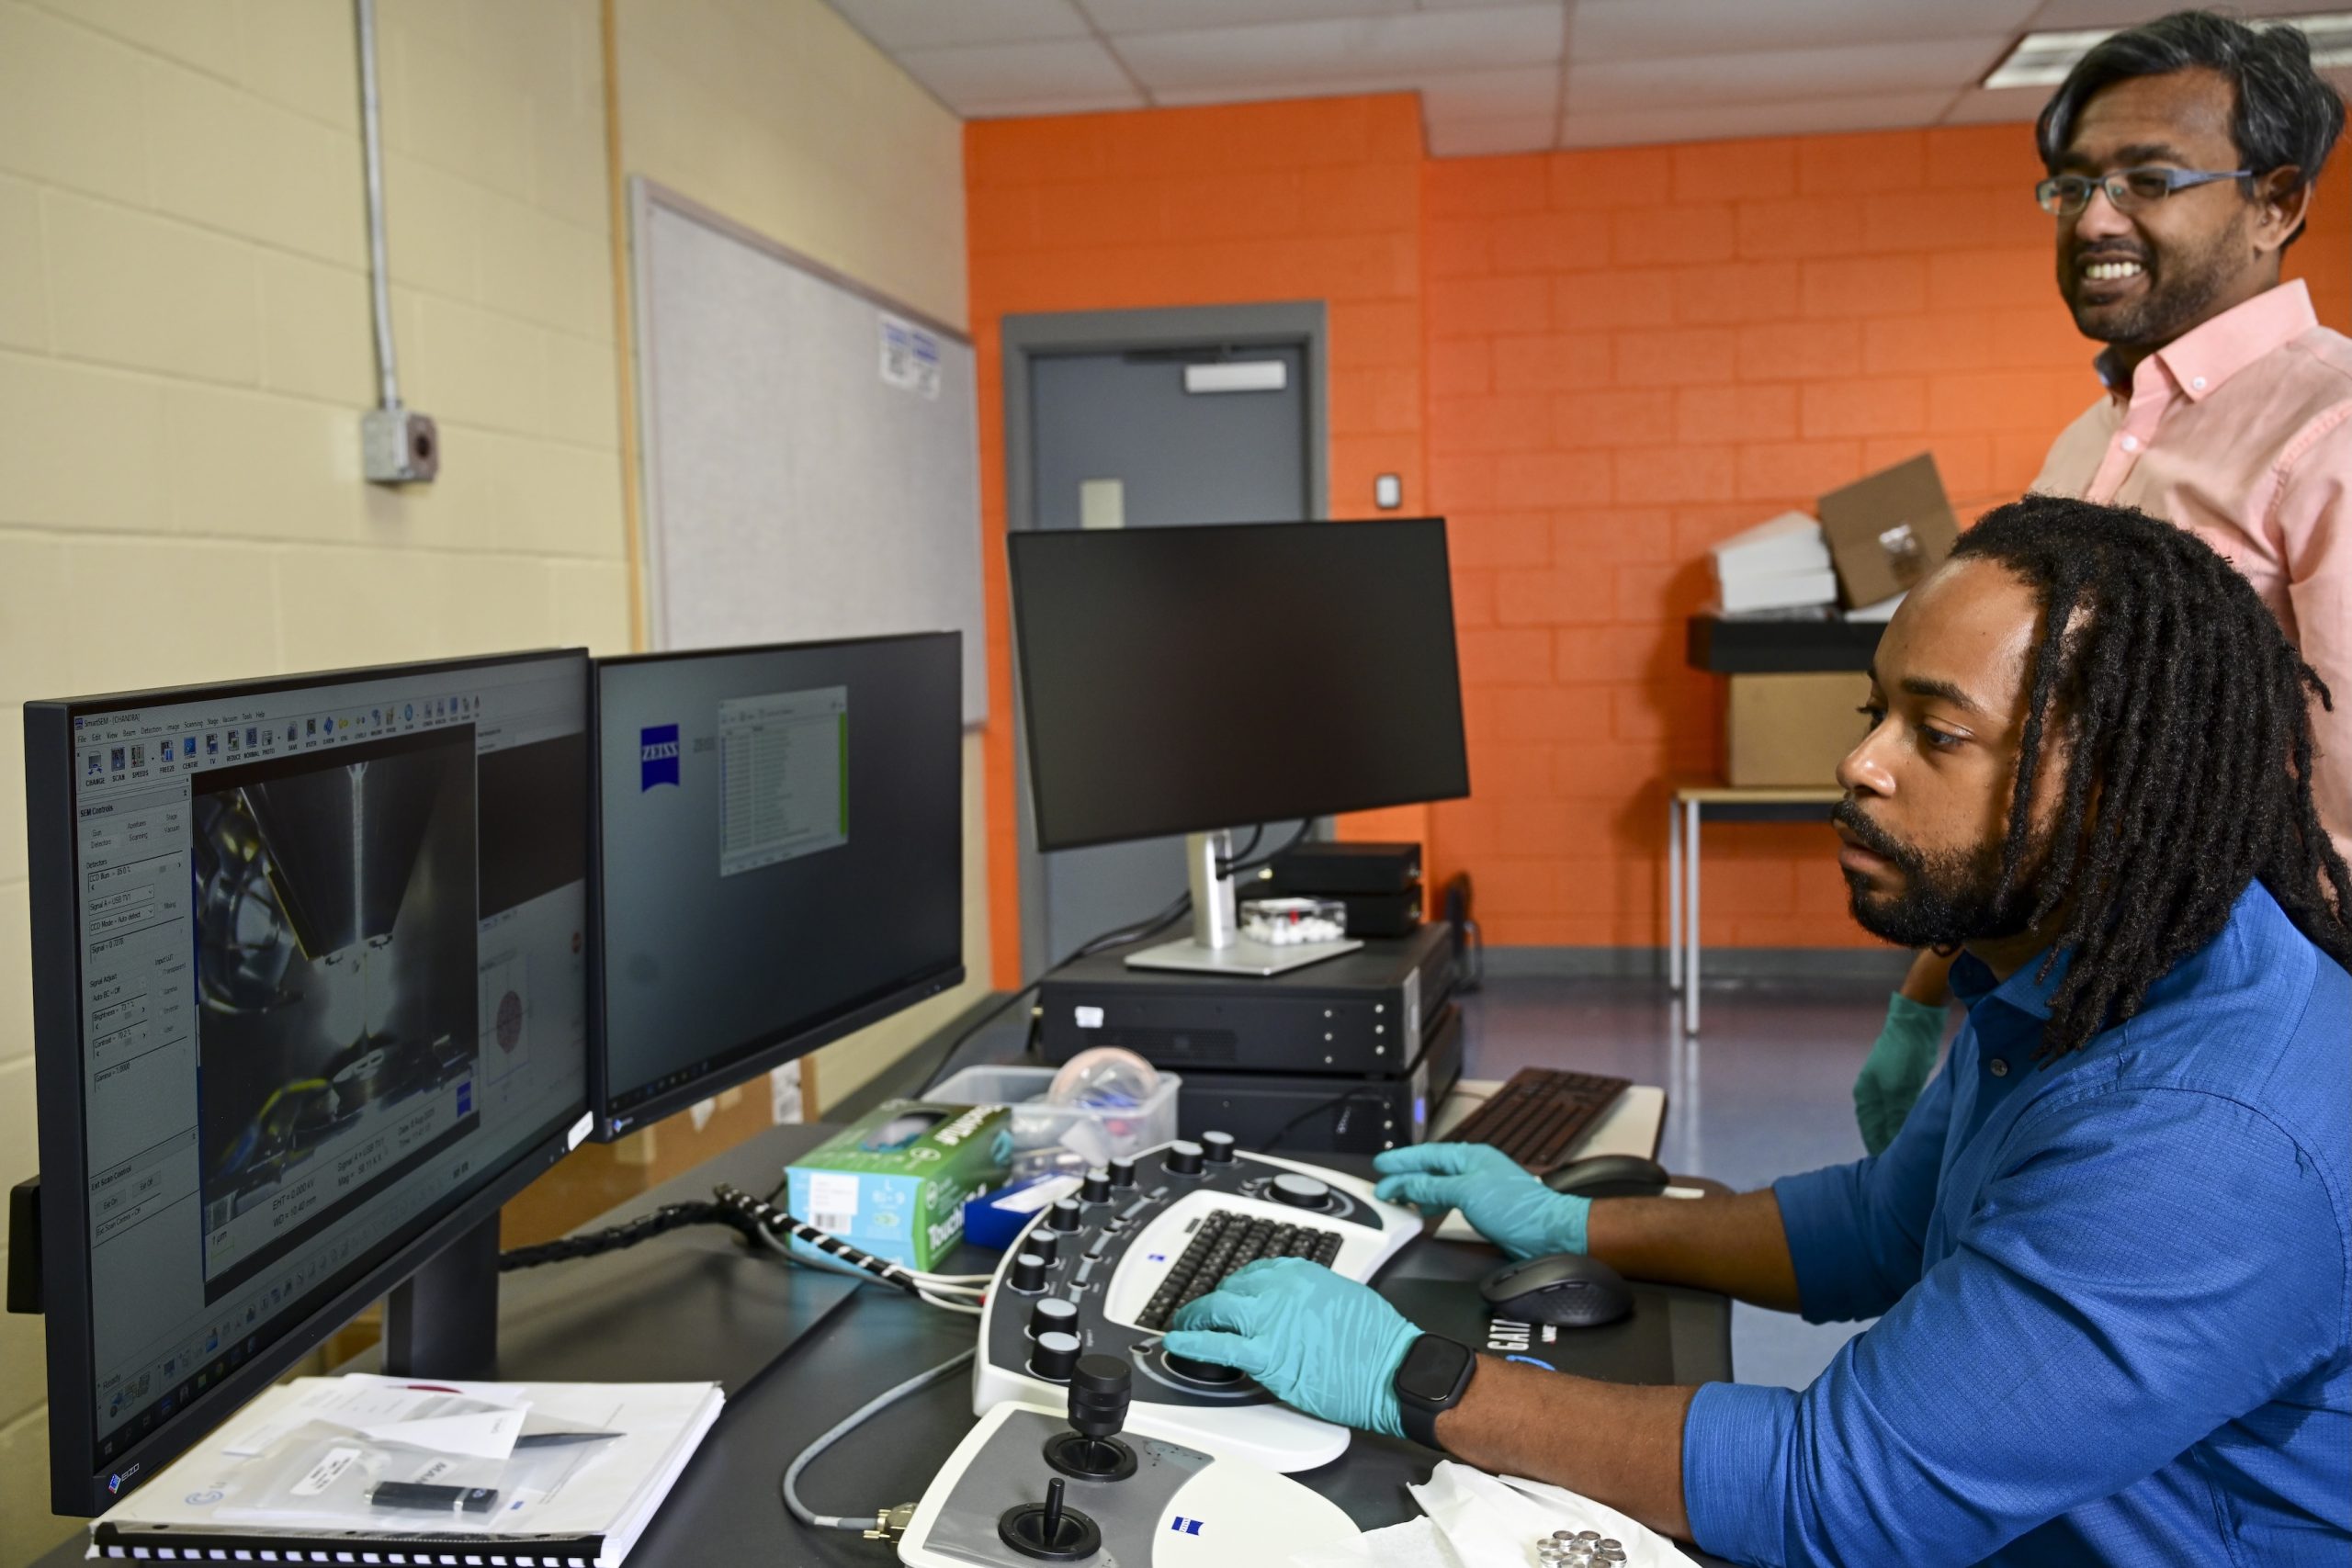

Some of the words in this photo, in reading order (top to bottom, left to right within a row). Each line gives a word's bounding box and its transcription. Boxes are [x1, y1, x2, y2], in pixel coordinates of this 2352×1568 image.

[85, 718, 108, 728] SmartSEM
[141, 726, 162, 735] Detection
[184, 720, 203, 728] Scanning
[643, 741, 678, 762] ZEISS
[112, 773, 125, 783] SCAN
[80, 808, 92, 818] SEM
[92, 805, 113, 815] Controls
[86, 859, 107, 869] Detectors
[101, 919, 113, 928] Mode
[94, 1010, 115, 1021] Brightness
[101, 1176, 114, 1185] Scan
[114, 1165, 132, 1179] Control
[272, 1196, 286, 1211] EHT
[103, 1373, 122, 1389] Ready
[121, 1462, 140, 1482] EIZO
